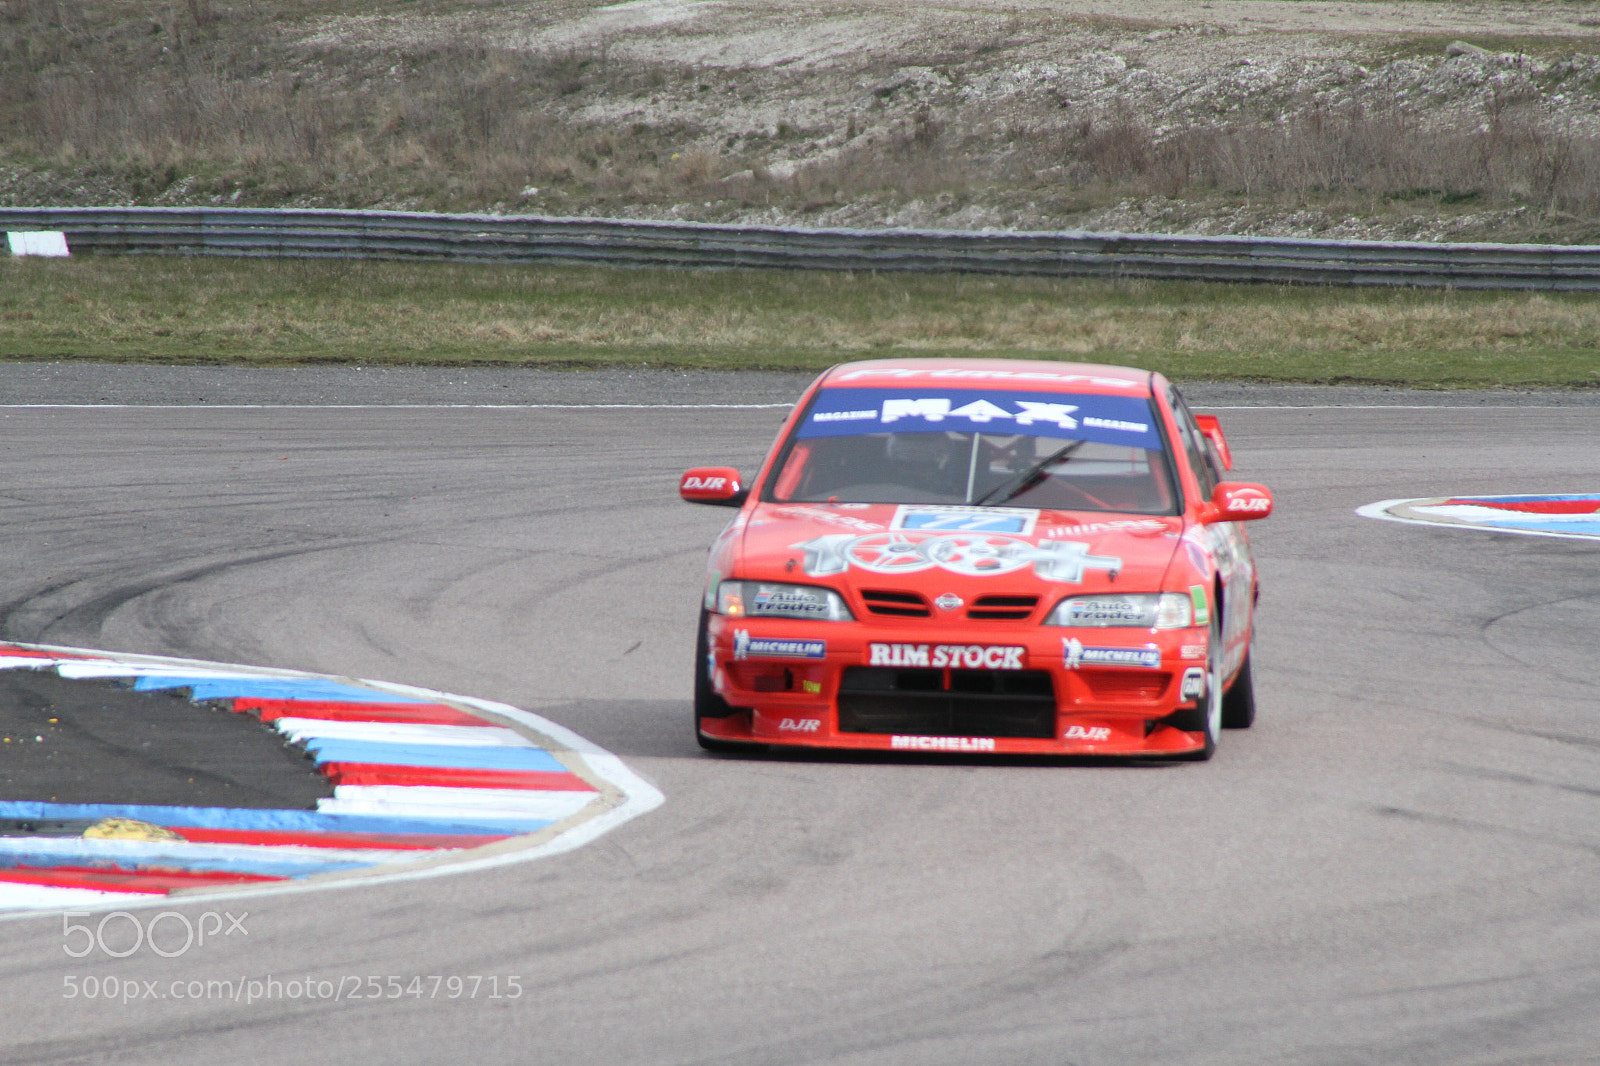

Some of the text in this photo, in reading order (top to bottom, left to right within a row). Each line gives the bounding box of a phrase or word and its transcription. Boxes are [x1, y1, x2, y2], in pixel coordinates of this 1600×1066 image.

[813, 409, 879, 422] MAGAZINE
[882, 398, 1080, 424] MAX
[1083, 416, 1149, 433] MAGAZINE
[682, 476, 728, 490] DJR
[1227, 497, 1272, 512] DJR
[769, 590, 818, 603] Auto
[754, 602, 829, 614] Trader
[1085, 600, 1134, 611] Auto
[1070, 609, 1147, 622] Trader
[750, 640, 824, 654] MICHELIN
[869, 643, 1024, 670] RIM STOCK
[1082, 648, 1158, 664] MICHELIN
[778, 718, 821, 733] DJR
[1064, 725, 1111, 741] DJR
[891, 735, 995, 752] MICHELIN
